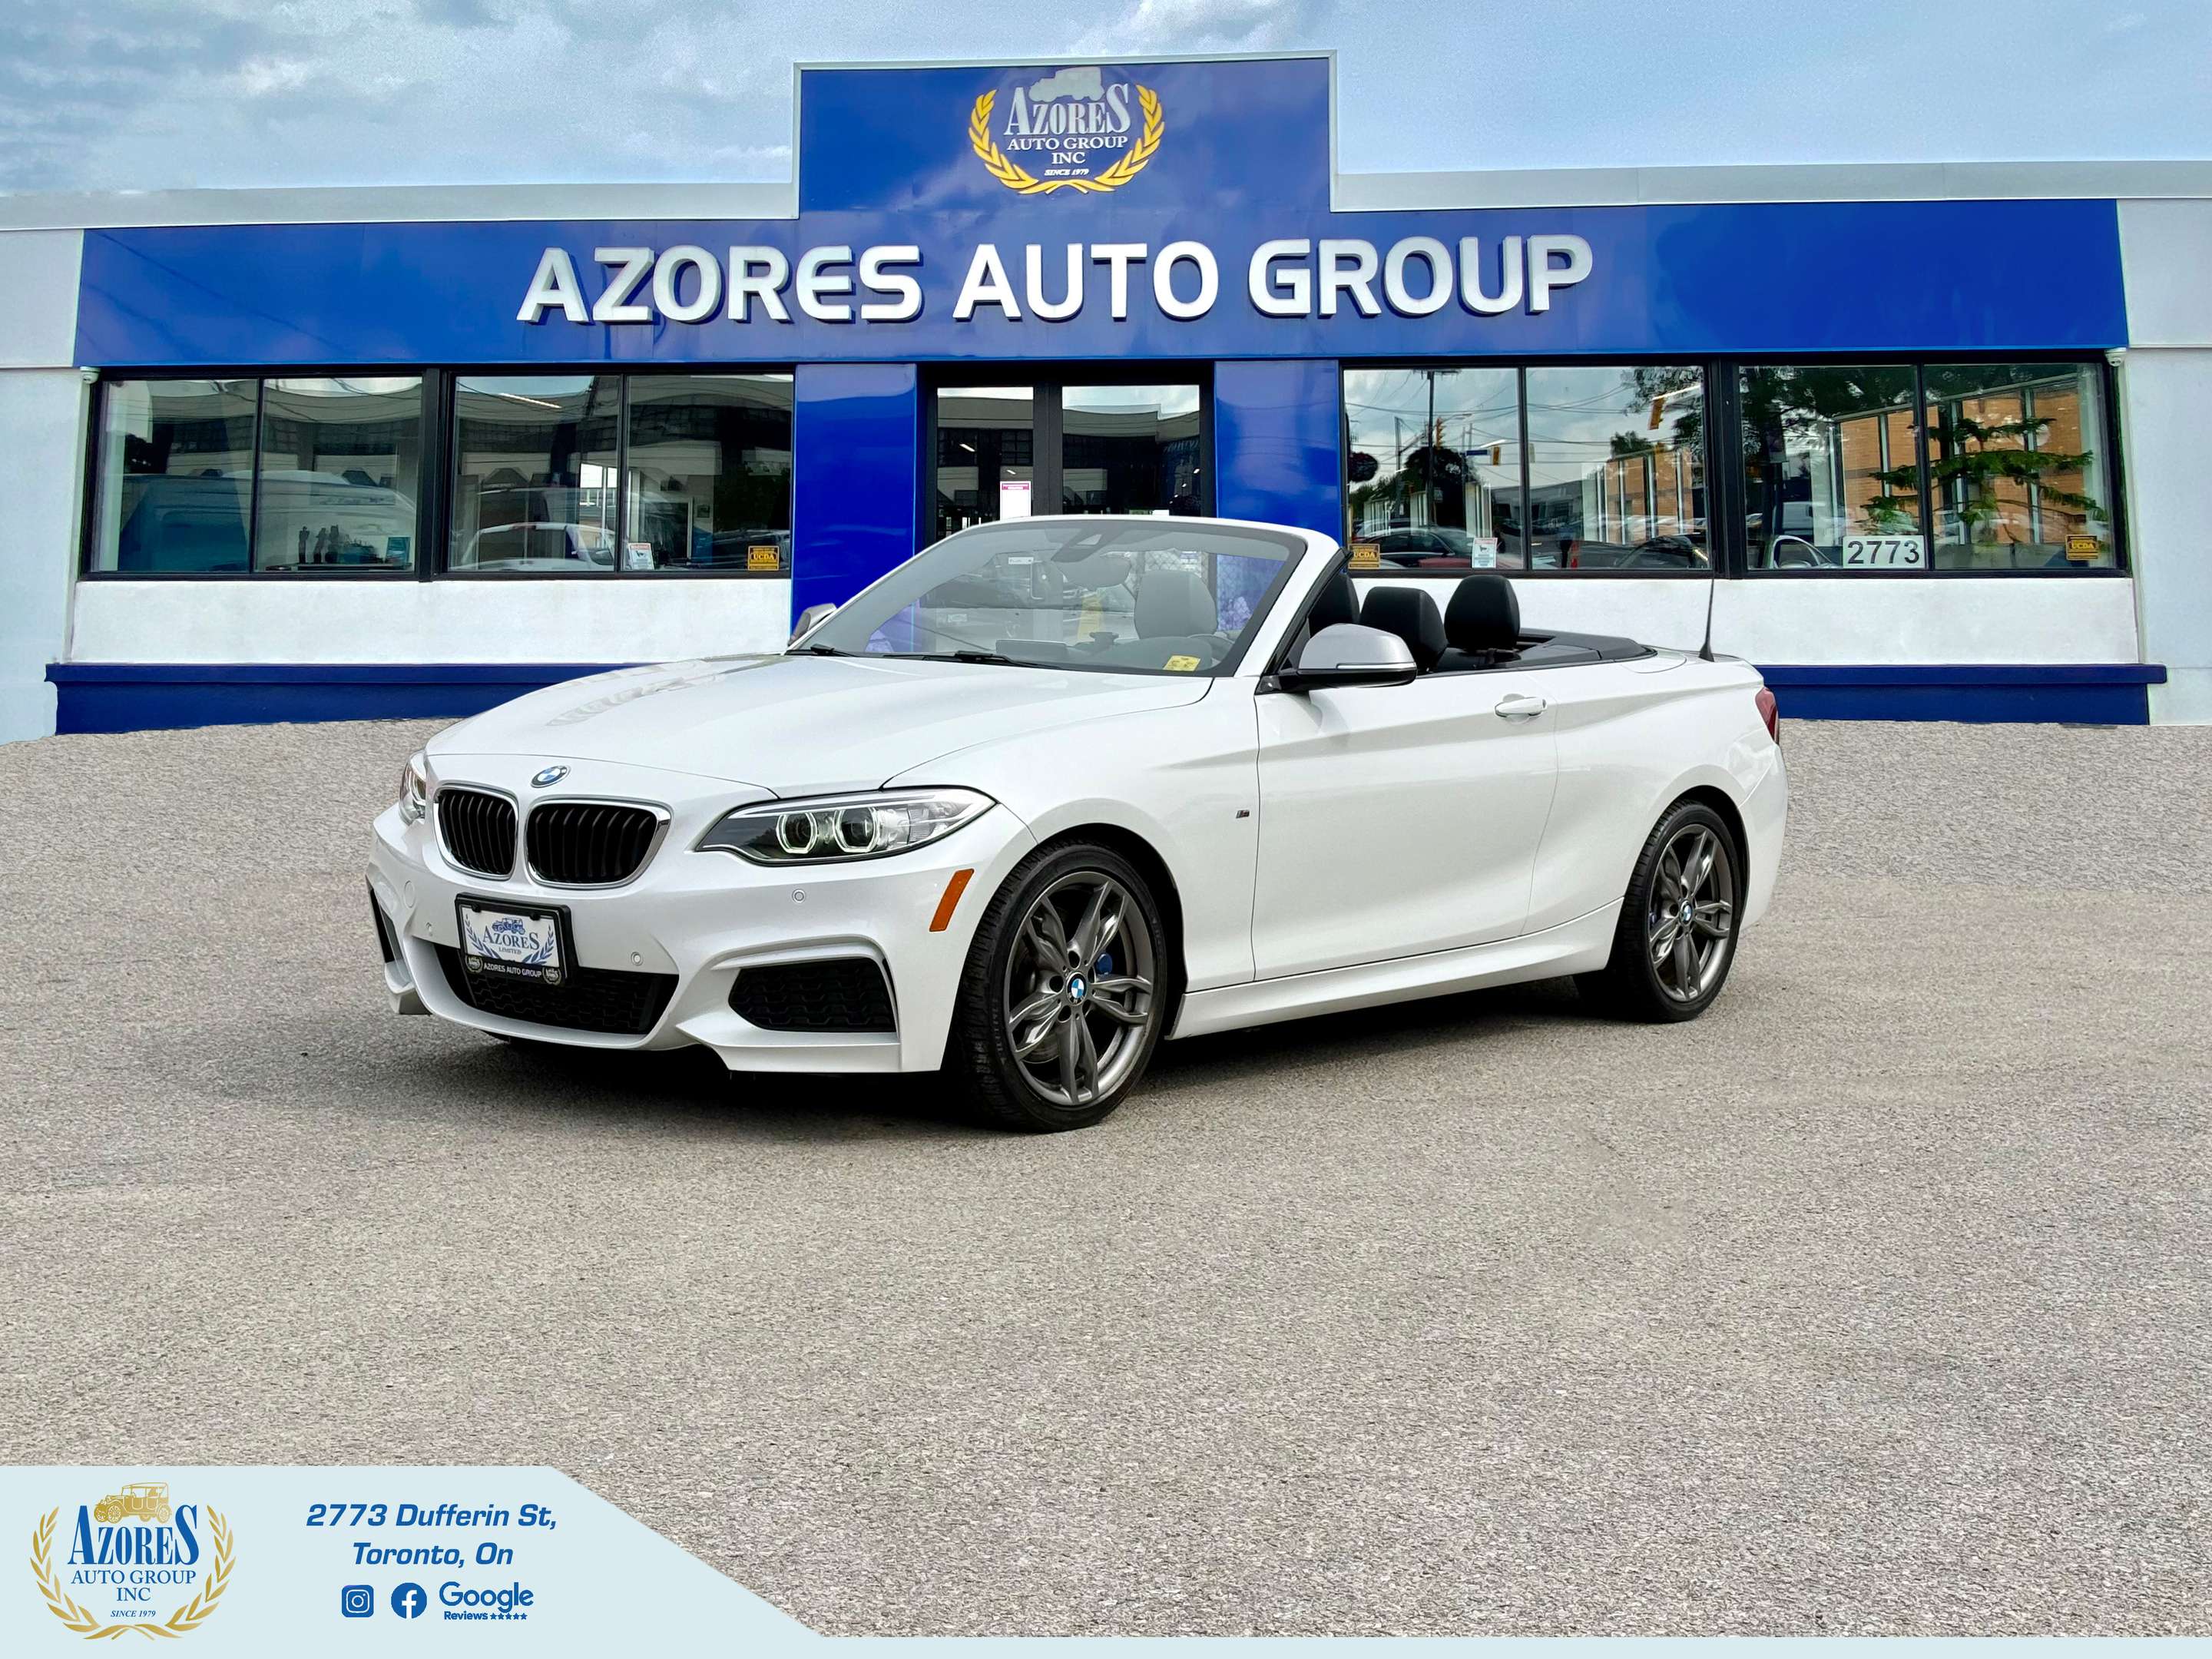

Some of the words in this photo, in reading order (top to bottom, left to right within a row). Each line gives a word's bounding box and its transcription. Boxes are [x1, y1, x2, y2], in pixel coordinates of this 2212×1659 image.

[1004, 84, 1131, 135] AZORES
[1007, 138, 1060, 151] AUTO
[1063, 136, 1128, 149] GROUP
[1051, 152, 1085, 164] INC
[515, 243, 923, 323] AZORES
[952, 240, 1220, 322] AUTO
[1248, 234, 1594, 320] GROUP
[1847, 540, 1920, 565] 2773
[482, 926, 540, 950] AZORES
[484, 962, 506, 972] AZORES
[506, 965, 522, 975] AUTO
[522, 969, 542, 978] GROUP
